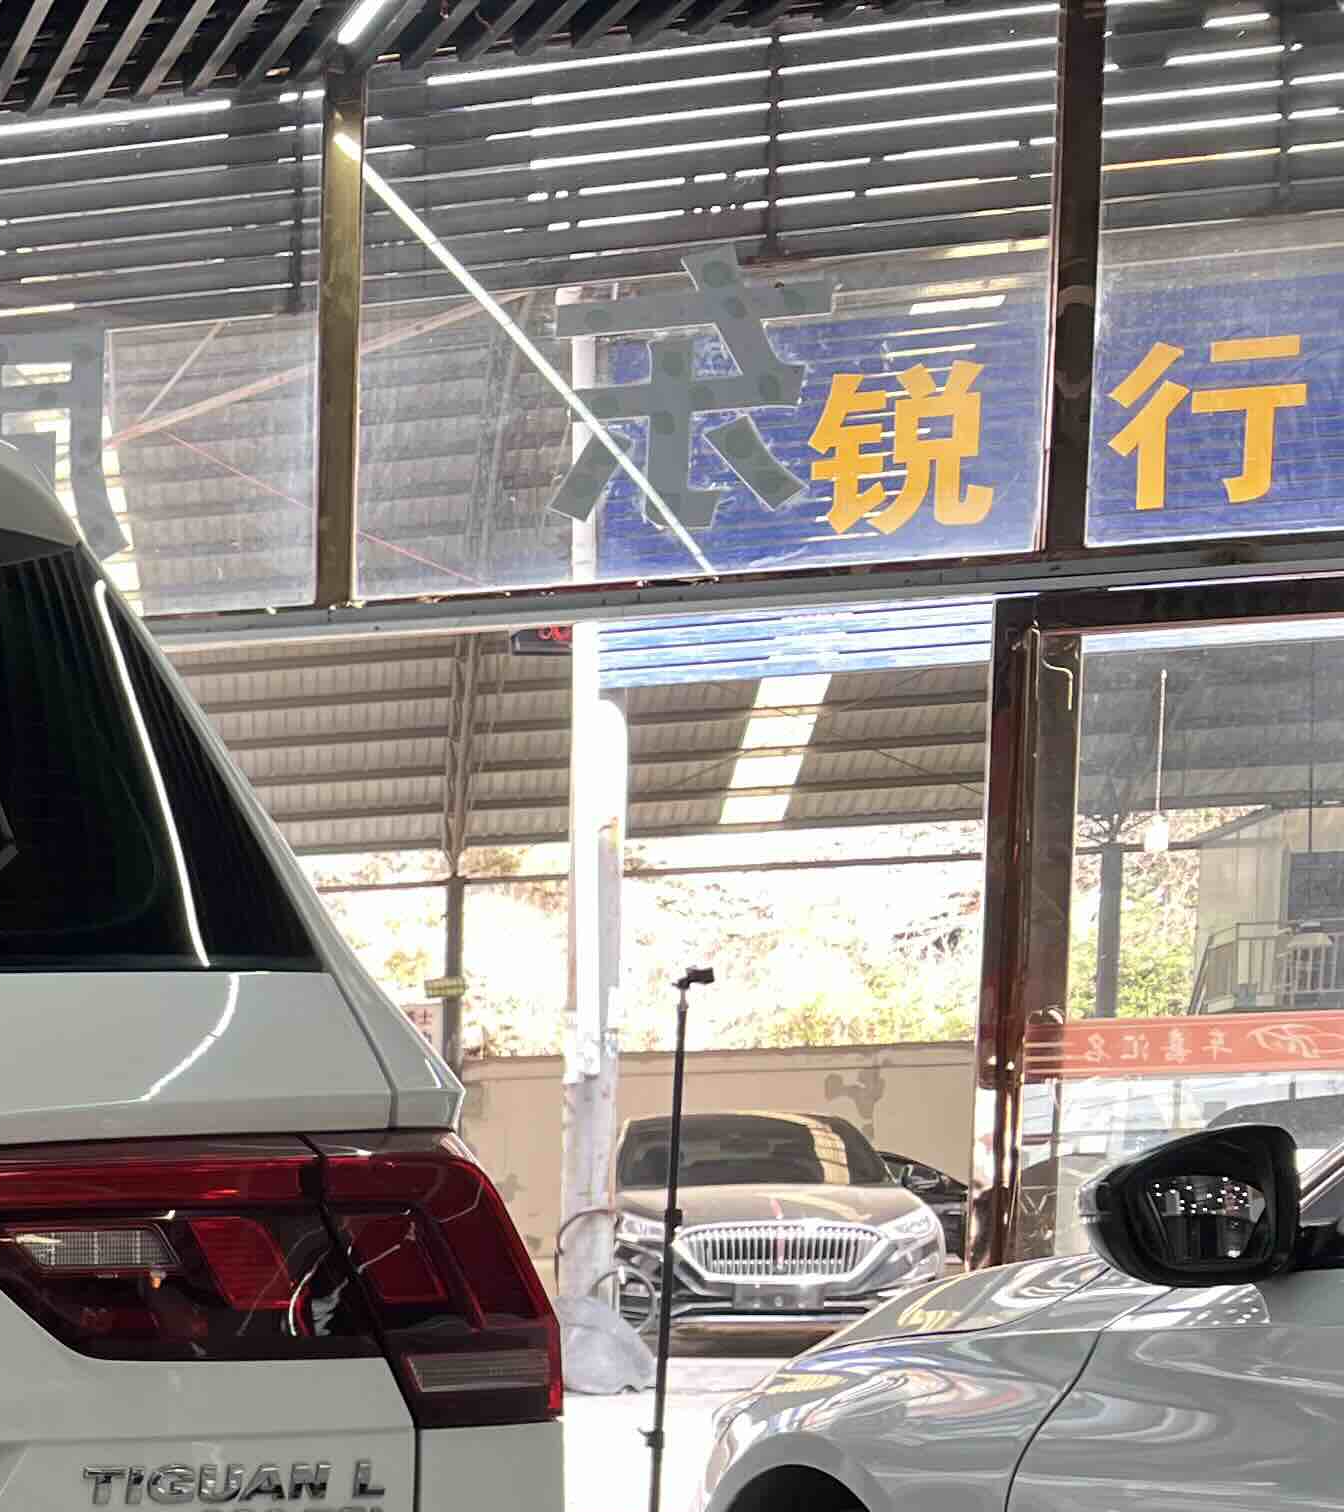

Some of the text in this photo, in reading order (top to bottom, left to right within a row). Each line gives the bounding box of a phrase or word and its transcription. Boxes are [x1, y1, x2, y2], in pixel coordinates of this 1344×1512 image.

[806, 333, 1308, 535] 锐行
[81, 1459, 386, 1505] TIGUAN L
